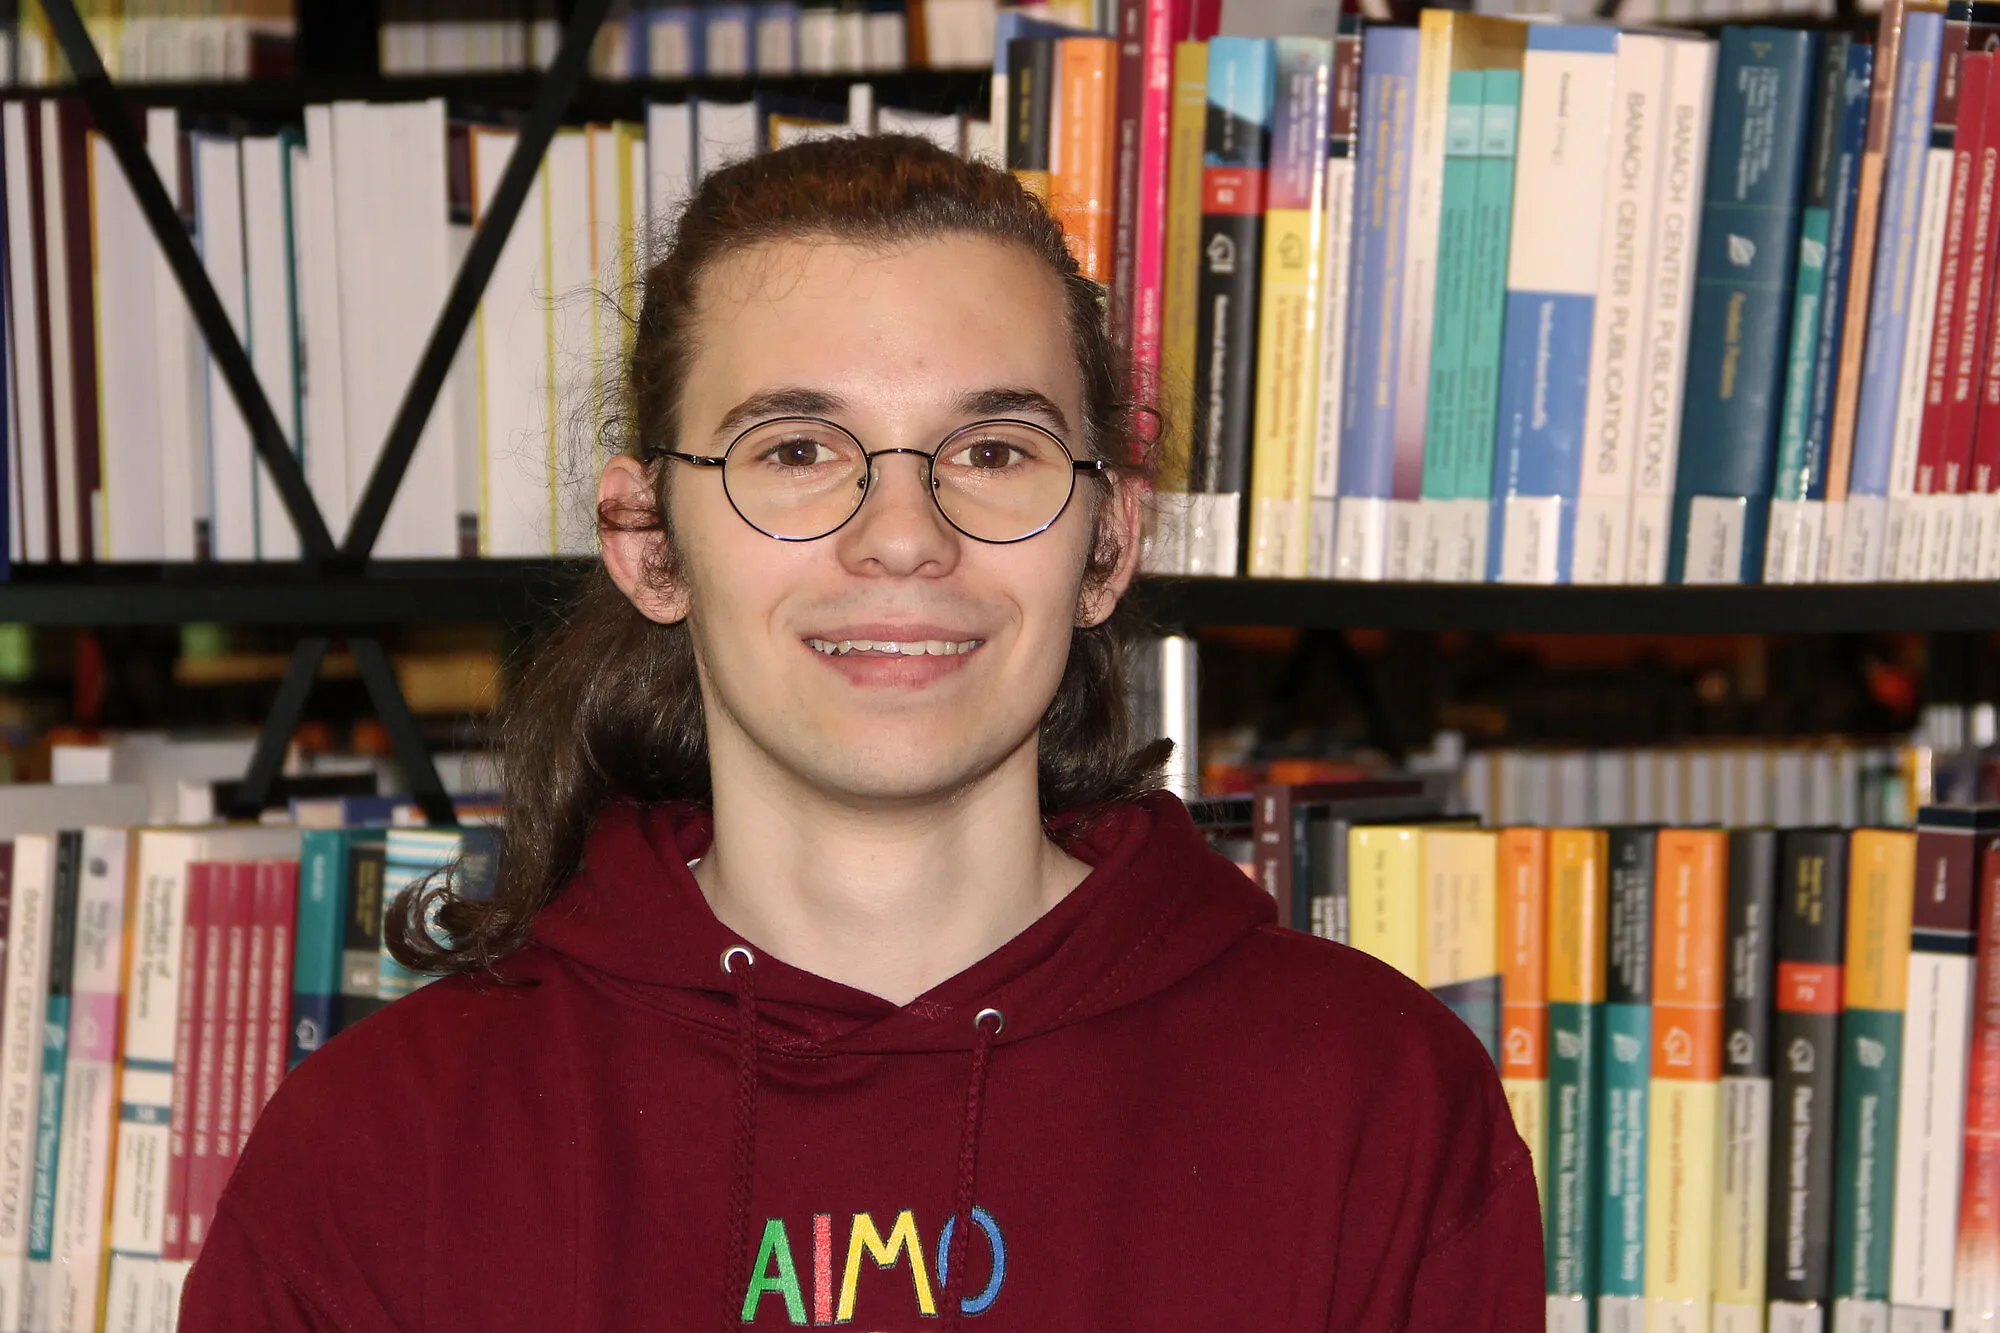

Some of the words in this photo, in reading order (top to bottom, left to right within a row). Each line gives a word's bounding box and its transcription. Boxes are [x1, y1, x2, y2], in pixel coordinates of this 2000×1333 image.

[1619, 93, 1646, 192] BANACH
[1669, 105, 1695, 203] BANACH
[1611, 201, 1639, 296] CENTER
[1948, 151, 1972, 254] CONGRESSUS
[1974, 148, 1998, 250] CONGRESSUS
[1656, 214, 1685, 309] CENTER
[1932, 258, 1959, 377] NUMERANTIUM
[1958, 255, 1986, 374] NUMERANTIUM
[1596, 307, 1632, 476] PUBLICATIONS
[1641, 321, 1677, 489] PUBLICATIONS
[17, 888, 40, 978] BANACH
[10, 986, 36, 1074] CENTER
[1792, 1086, 1814, 1121] Fluid
[0, 1083, 27, 1239] PUBLICATIONS
[1790, 1123, 1812, 1187] Structure
[741, 1205, 1007, 1326] AIMO
[1789, 1189, 1809, 1264] Interaction
